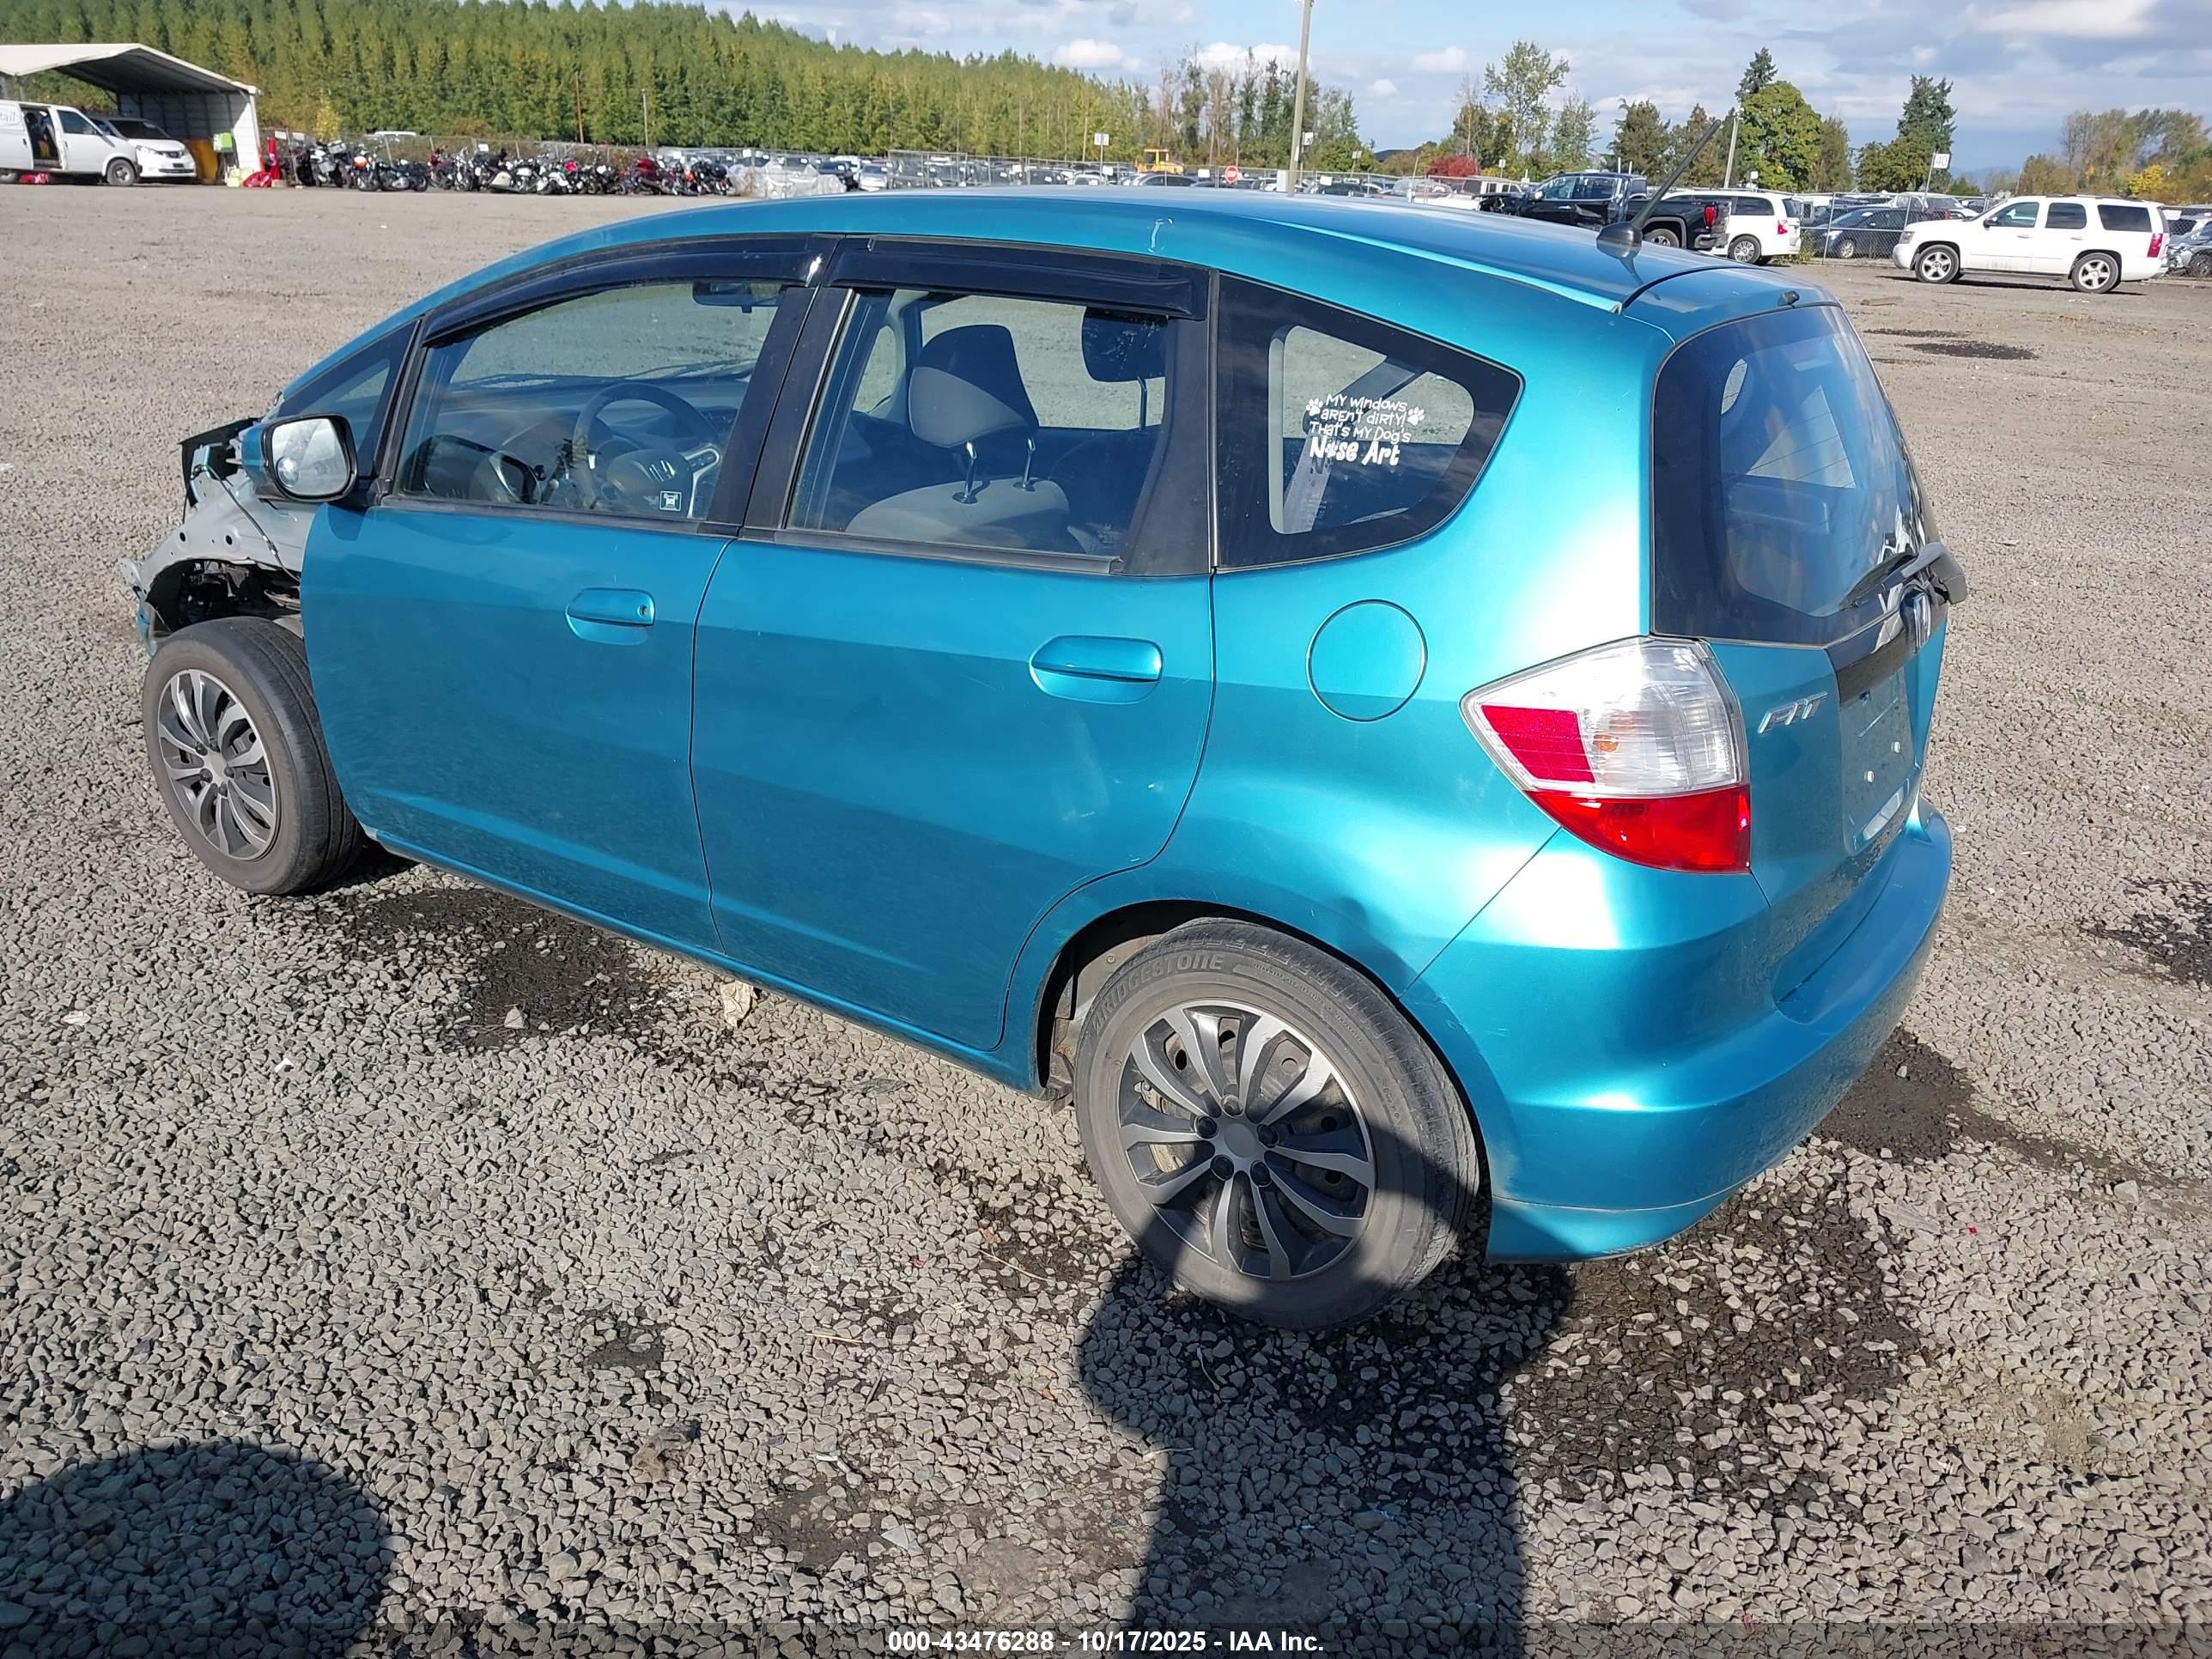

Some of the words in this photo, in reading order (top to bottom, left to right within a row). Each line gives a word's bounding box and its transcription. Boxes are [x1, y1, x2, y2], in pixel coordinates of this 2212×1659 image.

[1325, 393, 1347, 407] MY
[1350, 396, 1408, 412] windows
[1352, 426, 1373, 439] MY
[1373, 425, 1412, 445] Dog's
[1361, 441, 1401, 466] Art
[1758, 691, 1828, 734] FIT
